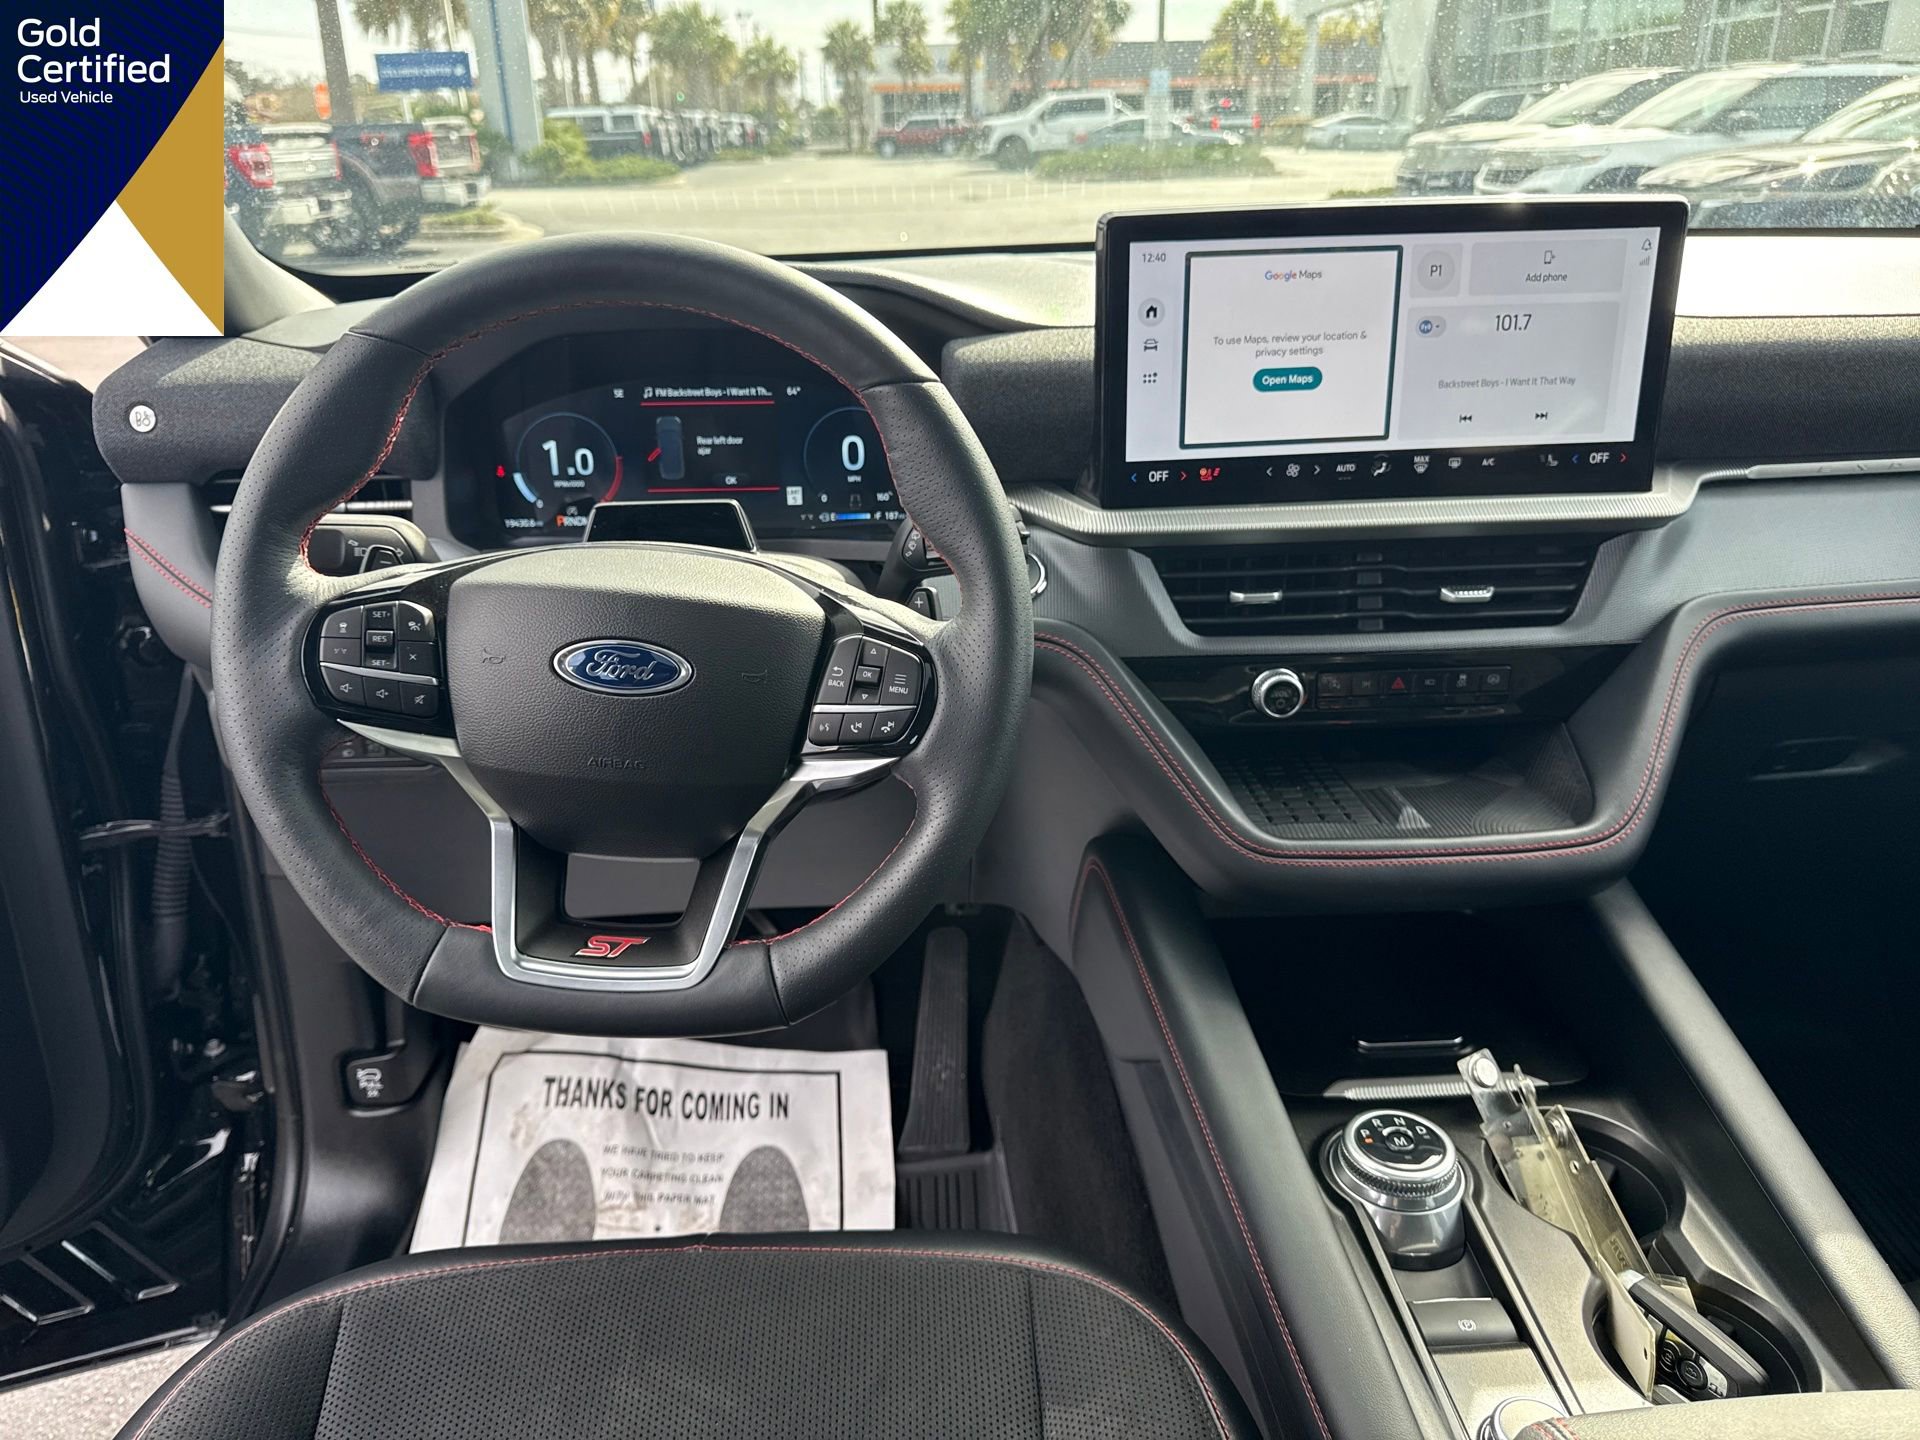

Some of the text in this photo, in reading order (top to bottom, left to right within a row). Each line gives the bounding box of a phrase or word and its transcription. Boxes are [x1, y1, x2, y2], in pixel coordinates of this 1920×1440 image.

[1142, 252, 1167, 263] 12:40
[1264, 270, 1322, 282] Google Maps
[1430, 264, 1443, 277] P1
[1525, 273, 1568, 283] Add phone
[1495, 313, 1532, 331] 101.7
[1213, 330, 1368, 347] To use Maps, review your location &
[1255, 346, 1324, 359] privacy settings
[1262, 374, 1314, 387] Open Maps
[1438, 379, 1480, 389] Backstreet
[1481, 378, 1500, 389] Boys
[1509, 378, 1530, 387] Want
[1531, 377, 1538, 386] It
[1539, 376, 1558, 386] That
[1558, 376, 1576, 387] Way
[655, 386, 667, 397] FM
[668, 386, 704, 397] Backstreet
[705, 386, 722, 398] Boys
[731, 386, 750, 397] Want
[696, 435, 744, 445] Rear left door
[541, 439, 595, 477] 1.0
[841, 434, 865, 471] 0
[1589, 452, 1610, 464] OFF
[1413, 455, 1430, 464] MAX
[1482, 457, 1496, 467] A/C
[1336, 463, 1356, 473] AUTO
[724, 475, 738, 485] OK
[1148, 470, 1170, 483] OFF
[372, 635, 388, 643] RES
[586, 649, 658, 681] Ford
[862, 670, 873, 678] OK
[828, 679, 845, 688] BACK
[889, 686, 909, 695] MENU
[587, 756, 646, 769] AIRBAG
[574, 935, 652, 958] ST
[544, 1076, 789, 1120] THANKS FOR COMING IN
[1371, 1118, 1383, 1128] R
[1393, 1116, 1406, 1127] N
[1360, 1128, 1371, 1138] P
[1415, 1125, 1428, 1136] D
[1393, 1136, 1408, 1147] M
